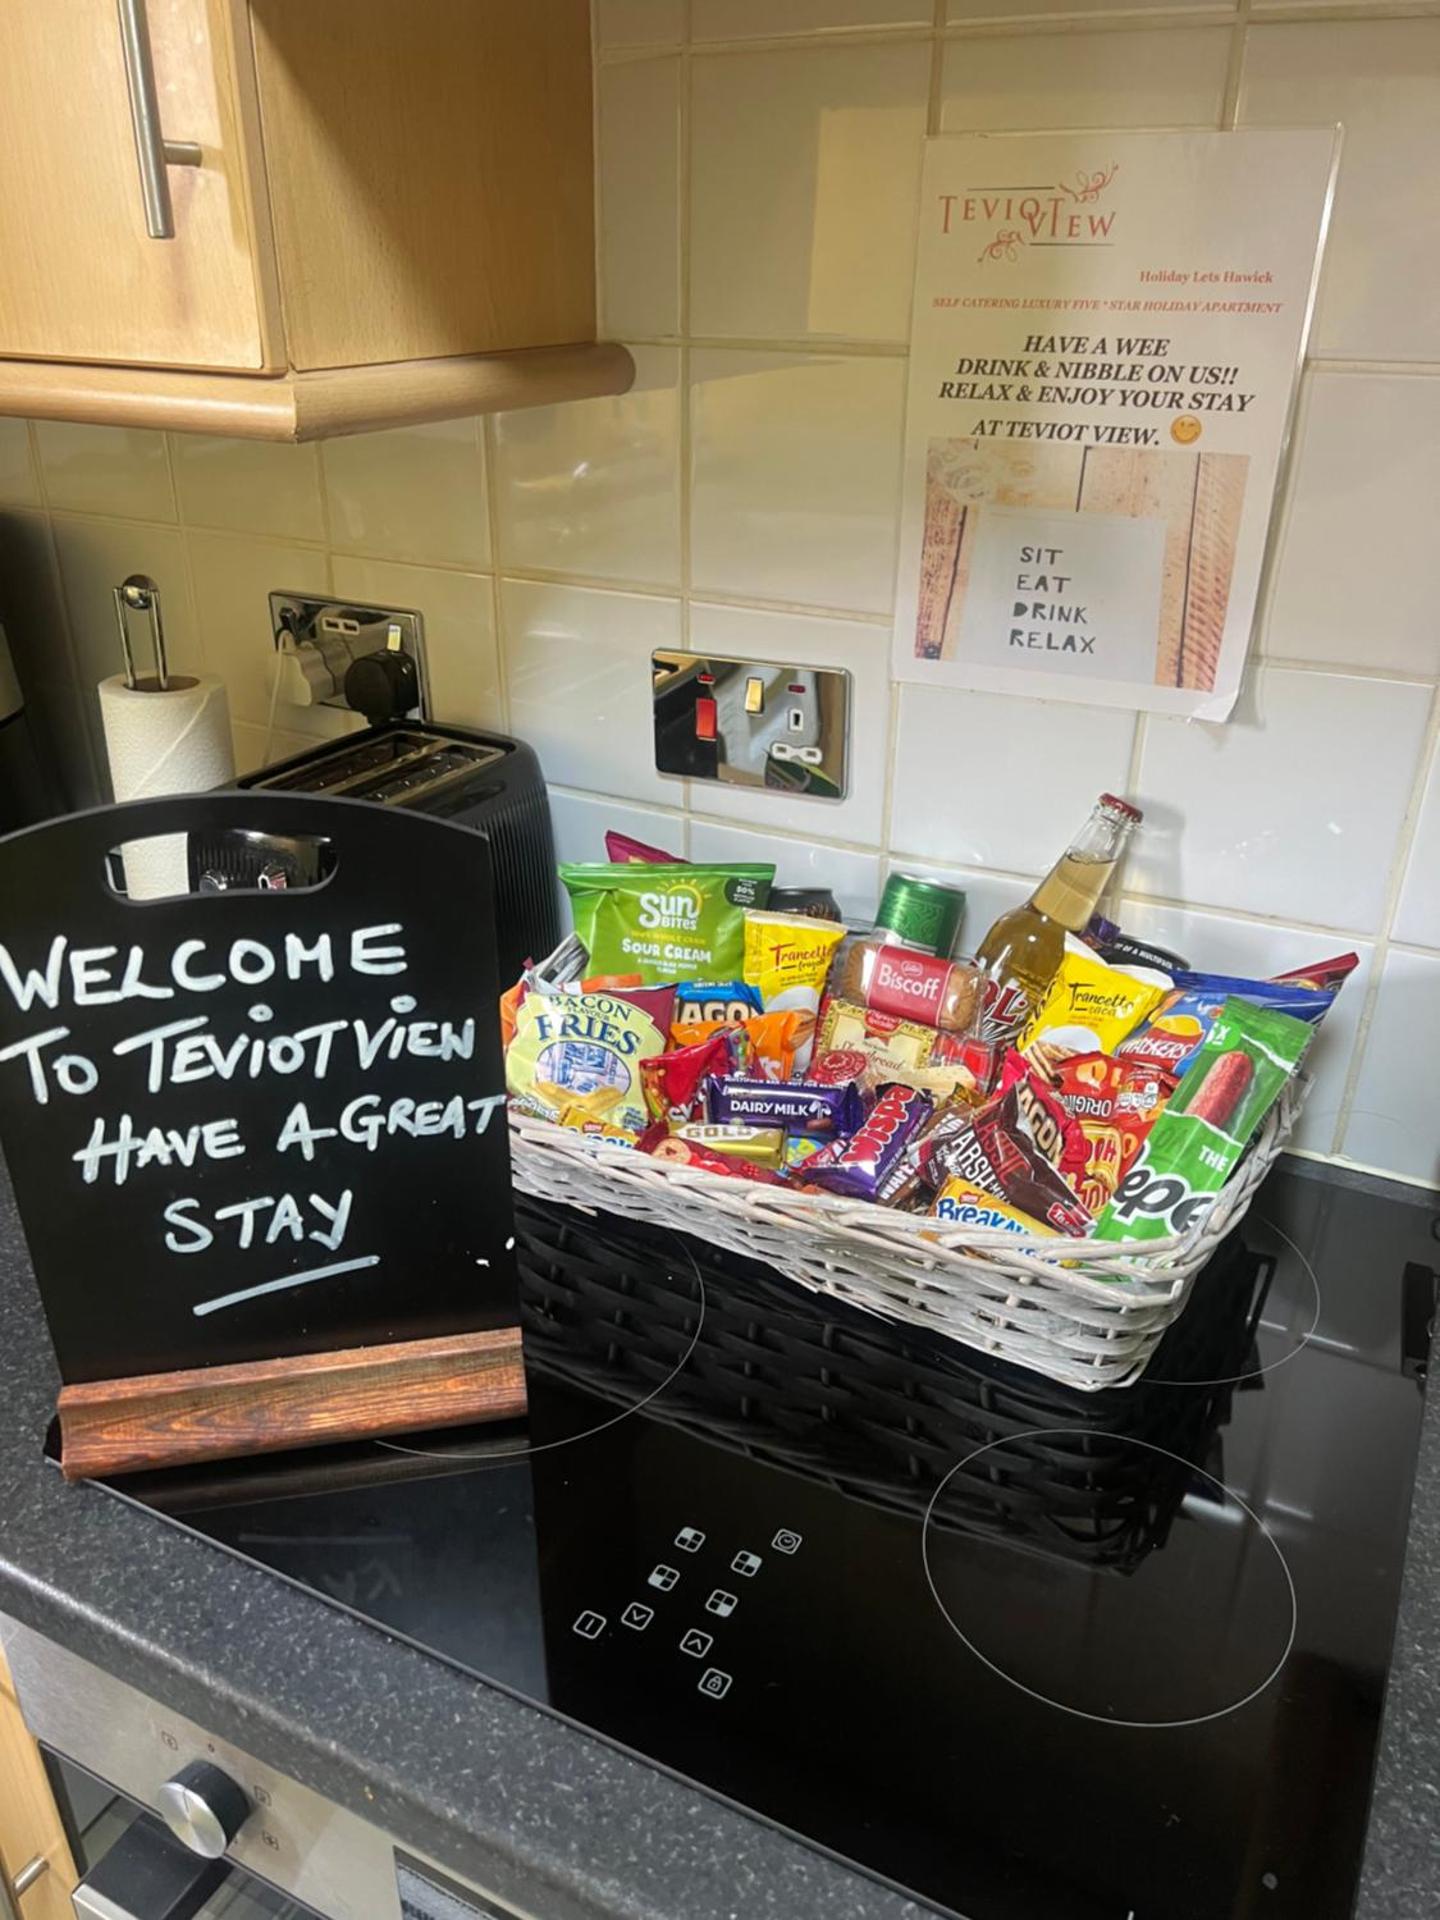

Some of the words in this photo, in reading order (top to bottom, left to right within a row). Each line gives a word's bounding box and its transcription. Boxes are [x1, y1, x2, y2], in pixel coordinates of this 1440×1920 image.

[1140, 270, 1189, 285] Holiday
[1193, 270, 1219, 284] Lets
[1223, 270, 1274, 284] Hawick
[932, 297, 961, 309] SELF
[961, 297, 1020, 309] CATERING
[1021, 298, 1070, 310] LUXURY
[1071, 299, 1100, 311] FIVE
[1142, 301, 1200, 313] HOLIDAY
[1201, 302, 1284, 314] APARTMENT
[1023, 335, 1090, 354] HAVE
[1091, 337, 1107, 355] A
[1115, 337, 1171, 357] WEE
[956, 358, 1032, 377] DRINK
[1034, 360, 1051, 379] &
[1054, 361, 1144, 382] NIBBLE
[1147, 364, 1186, 384] ON
[1189, 366, 1239, 386] US!!
[938, 381, 1014, 401] RELAX
[1016, 384, 1032, 402] &
[1037, 385, 1115, 407] ENJOY
[1118, 389, 1185, 410] YOUR
[1187, 391, 1256, 413] STAY
[970, 419, 1003, 436] AT
[1005, 420, 1089, 441] TEVIOT
[1092, 425, 1161, 447] VIEW.
[1019, 547, 1064, 566] SIT
[1017, 574, 1071, 594] EAT
[1012, 602, 1089, 625] DRINK
[1009, 628, 1097, 655] RELAX
[638, 892, 701, 929] Sun
[622, 937, 660, 957] SOUR
[664, 943, 712, 964] CREAM
[0, 922, 409, 1012] WELCOME
[877, 963, 941, 1001] Biscoff
[673, 1001, 761, 1025] AGO
[534, 1012, 642, 1055] FRIES
[730, 1100, 775, 1115] DAIRY
[774, 1103, 810, 1117] MILK
[686, 1125, 751, 1139] GOLD
[839, 1084, 917, 1165] Wispa
[72, 1113, 246, 1186] HAVE
[276, 1102, 339, 1161] A
[340, 1095, 507, 1152] GREAT
[1198, 1145, 1230, 1173] THE
[164, 1188, 354, 1254] STAY
